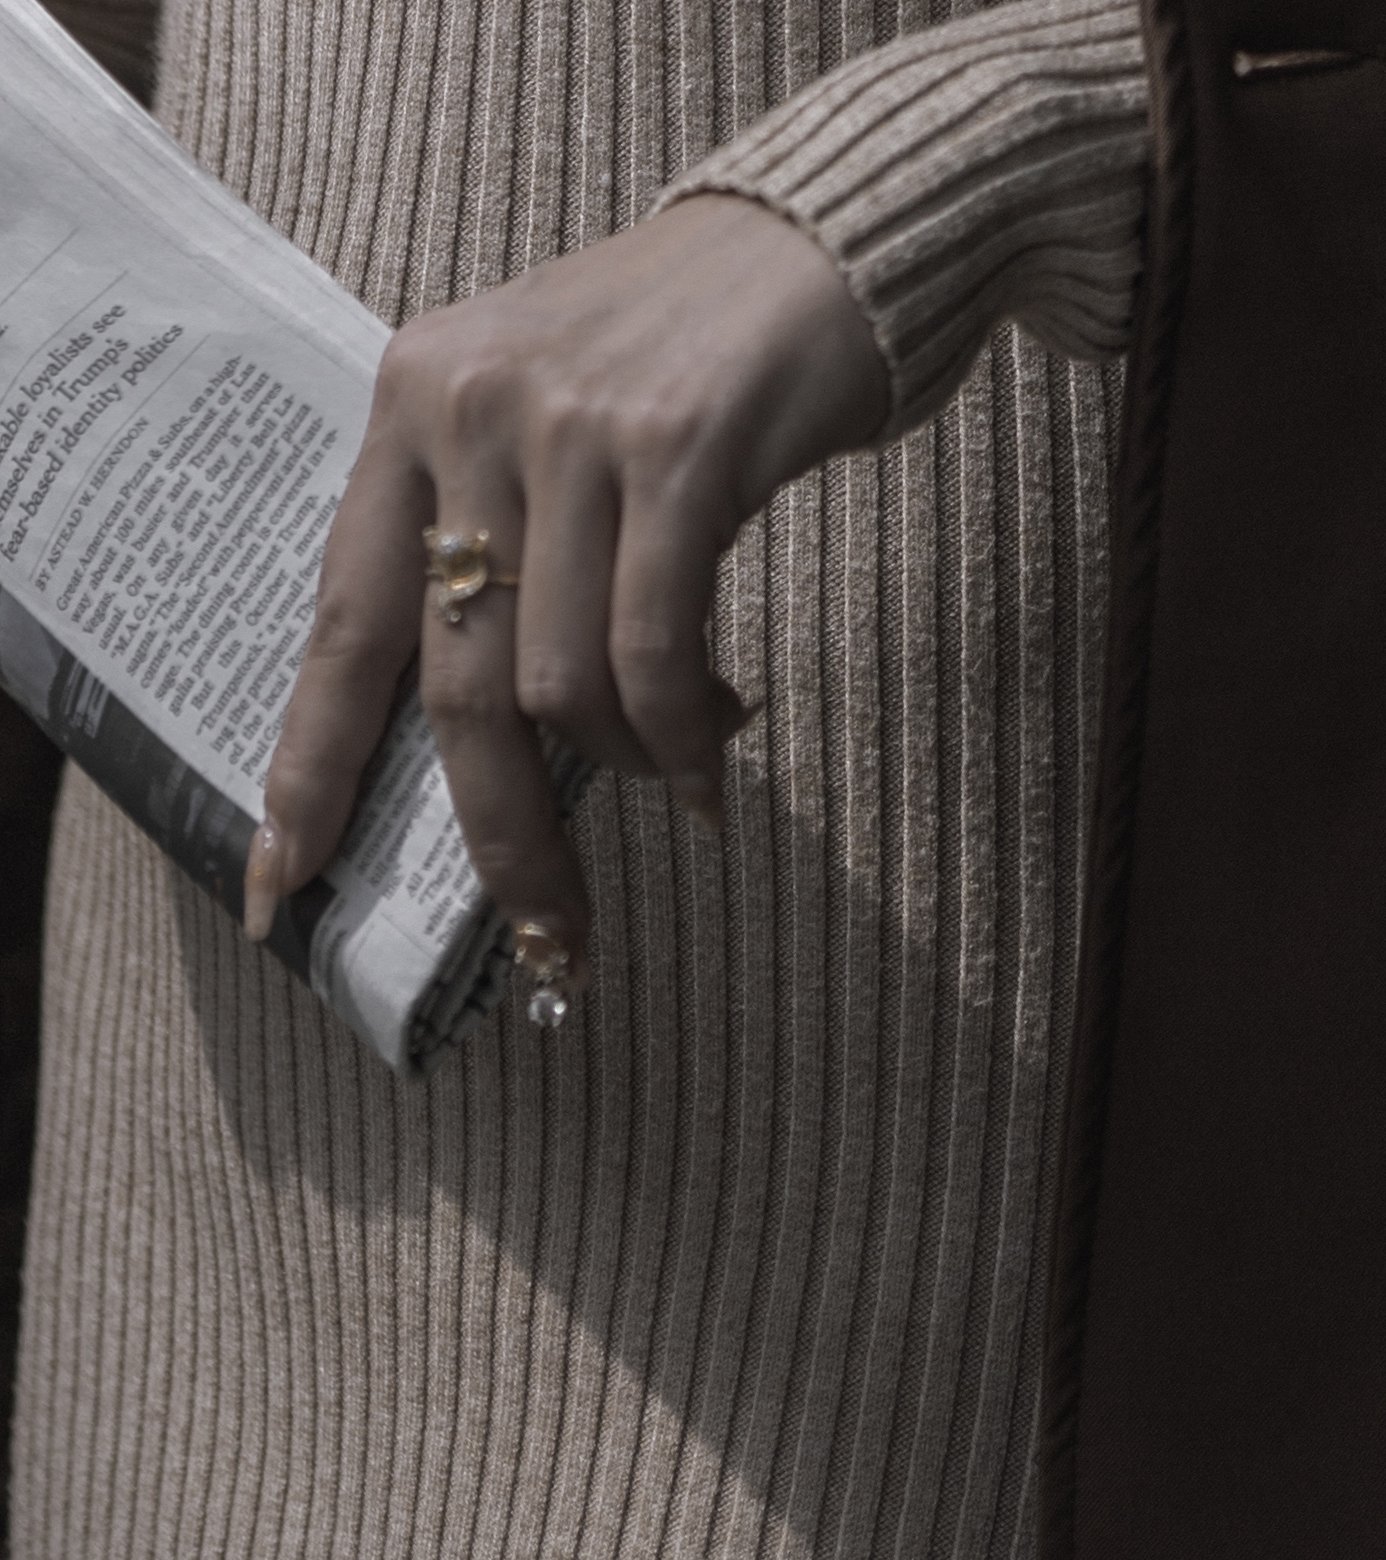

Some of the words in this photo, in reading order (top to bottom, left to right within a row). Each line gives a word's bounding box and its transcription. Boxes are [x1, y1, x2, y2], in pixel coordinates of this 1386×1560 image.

[19, 332, 93, 402] loyalists
[92, 305, 126, 333] see
[54, 382, 122, 454] identity
[120, 324, 183, 386] politics
[203, 386, 215, 396] a
[208, 355, 241, 388] high-
[37, 405, 63, 429] in
[157, 415, 194, 450] Subs,
[189, 396, 207, 413] on
[70, 592, 91, 623] way
[89, 546, 118, 590] about
[113, 517, 135, 544] 100
[133, 475, 165, 516] miles
[164, 407, 219, 473] southeast
[217, 388, 233, 405] of
[229, 363, 256, 388] Las
[82, 592, 116, 634] Vegas,
[112, 554, 135, 583] was
[130, 504, 167, 552] busier
[166, 471, 191, 502] and
[186, 406, 241, 469] Trumpier
[240, 372, 270, 403] than
[118, 461, 153, 500] Pizza
[148, 449, 163, 462] &
[187, 509, 211, 541] and
[249, 417, 277, 448] Bell
[272, 394, 294, 417] La-
[34, 568, 50, 592] BY
[47, 508, 82, 570] ASTEAD
[77, 490, 94, 506] W.
[89, 417, 149, 490] HERNDON
[78, 500, 126, 571] American
[98, 606, 127, 650] usual.
[125, 574, 147, 597] On
[146, 537, 170, 567] any
[170, 489, 203, 534] given
[205, 453, 229, 482] day
[228, 434, 242, 447] it
[245, 382, 282, 428] serves
[140, 639, 172, 689] comes
[207, 545, 235, 576] with
[230, 472, 284, 549] pepperoni
[280, 443, 304, 475] and
[299, 416, 323, 447] sau-
[153, 591, 179, 619] The
[279, 403, 312, 444] pizza
[175, 629, 200, 658] The
[198, 581, 235, 628] dining
[229, 542, 261, 581] room
[255, 526, 271, 541] is
[268, 465, 312, 525] covered
[307, 450, 324, 467] in
[320, 429, 337, 449] re-
[56, 568, 84, 611] Great
[168, 676, 195, 717] galia
[190, 613, 237, 678] praising
[228, 544, 282, 614] President
[275, 495, 319, 542] Trump.
[190, 680, 214, 710] But
[217, 639, 242, 668] this
[245, 568, 288, 626] October
[293, 494, 342, 557] morning
[266, 622, 278, 634] a
[273, 579, 304, 623] small
[209, 725, 235, 752] ing
[227, 698, 250, 725] the
[246, 626, 299, 700] president.
[292, 594, 320, 622] The
[228, 741, 245, 764] ed
[241, 713, 263, 740] the
[259, 672, 289, 711] local
[240, 739, 269, 777] Paul
